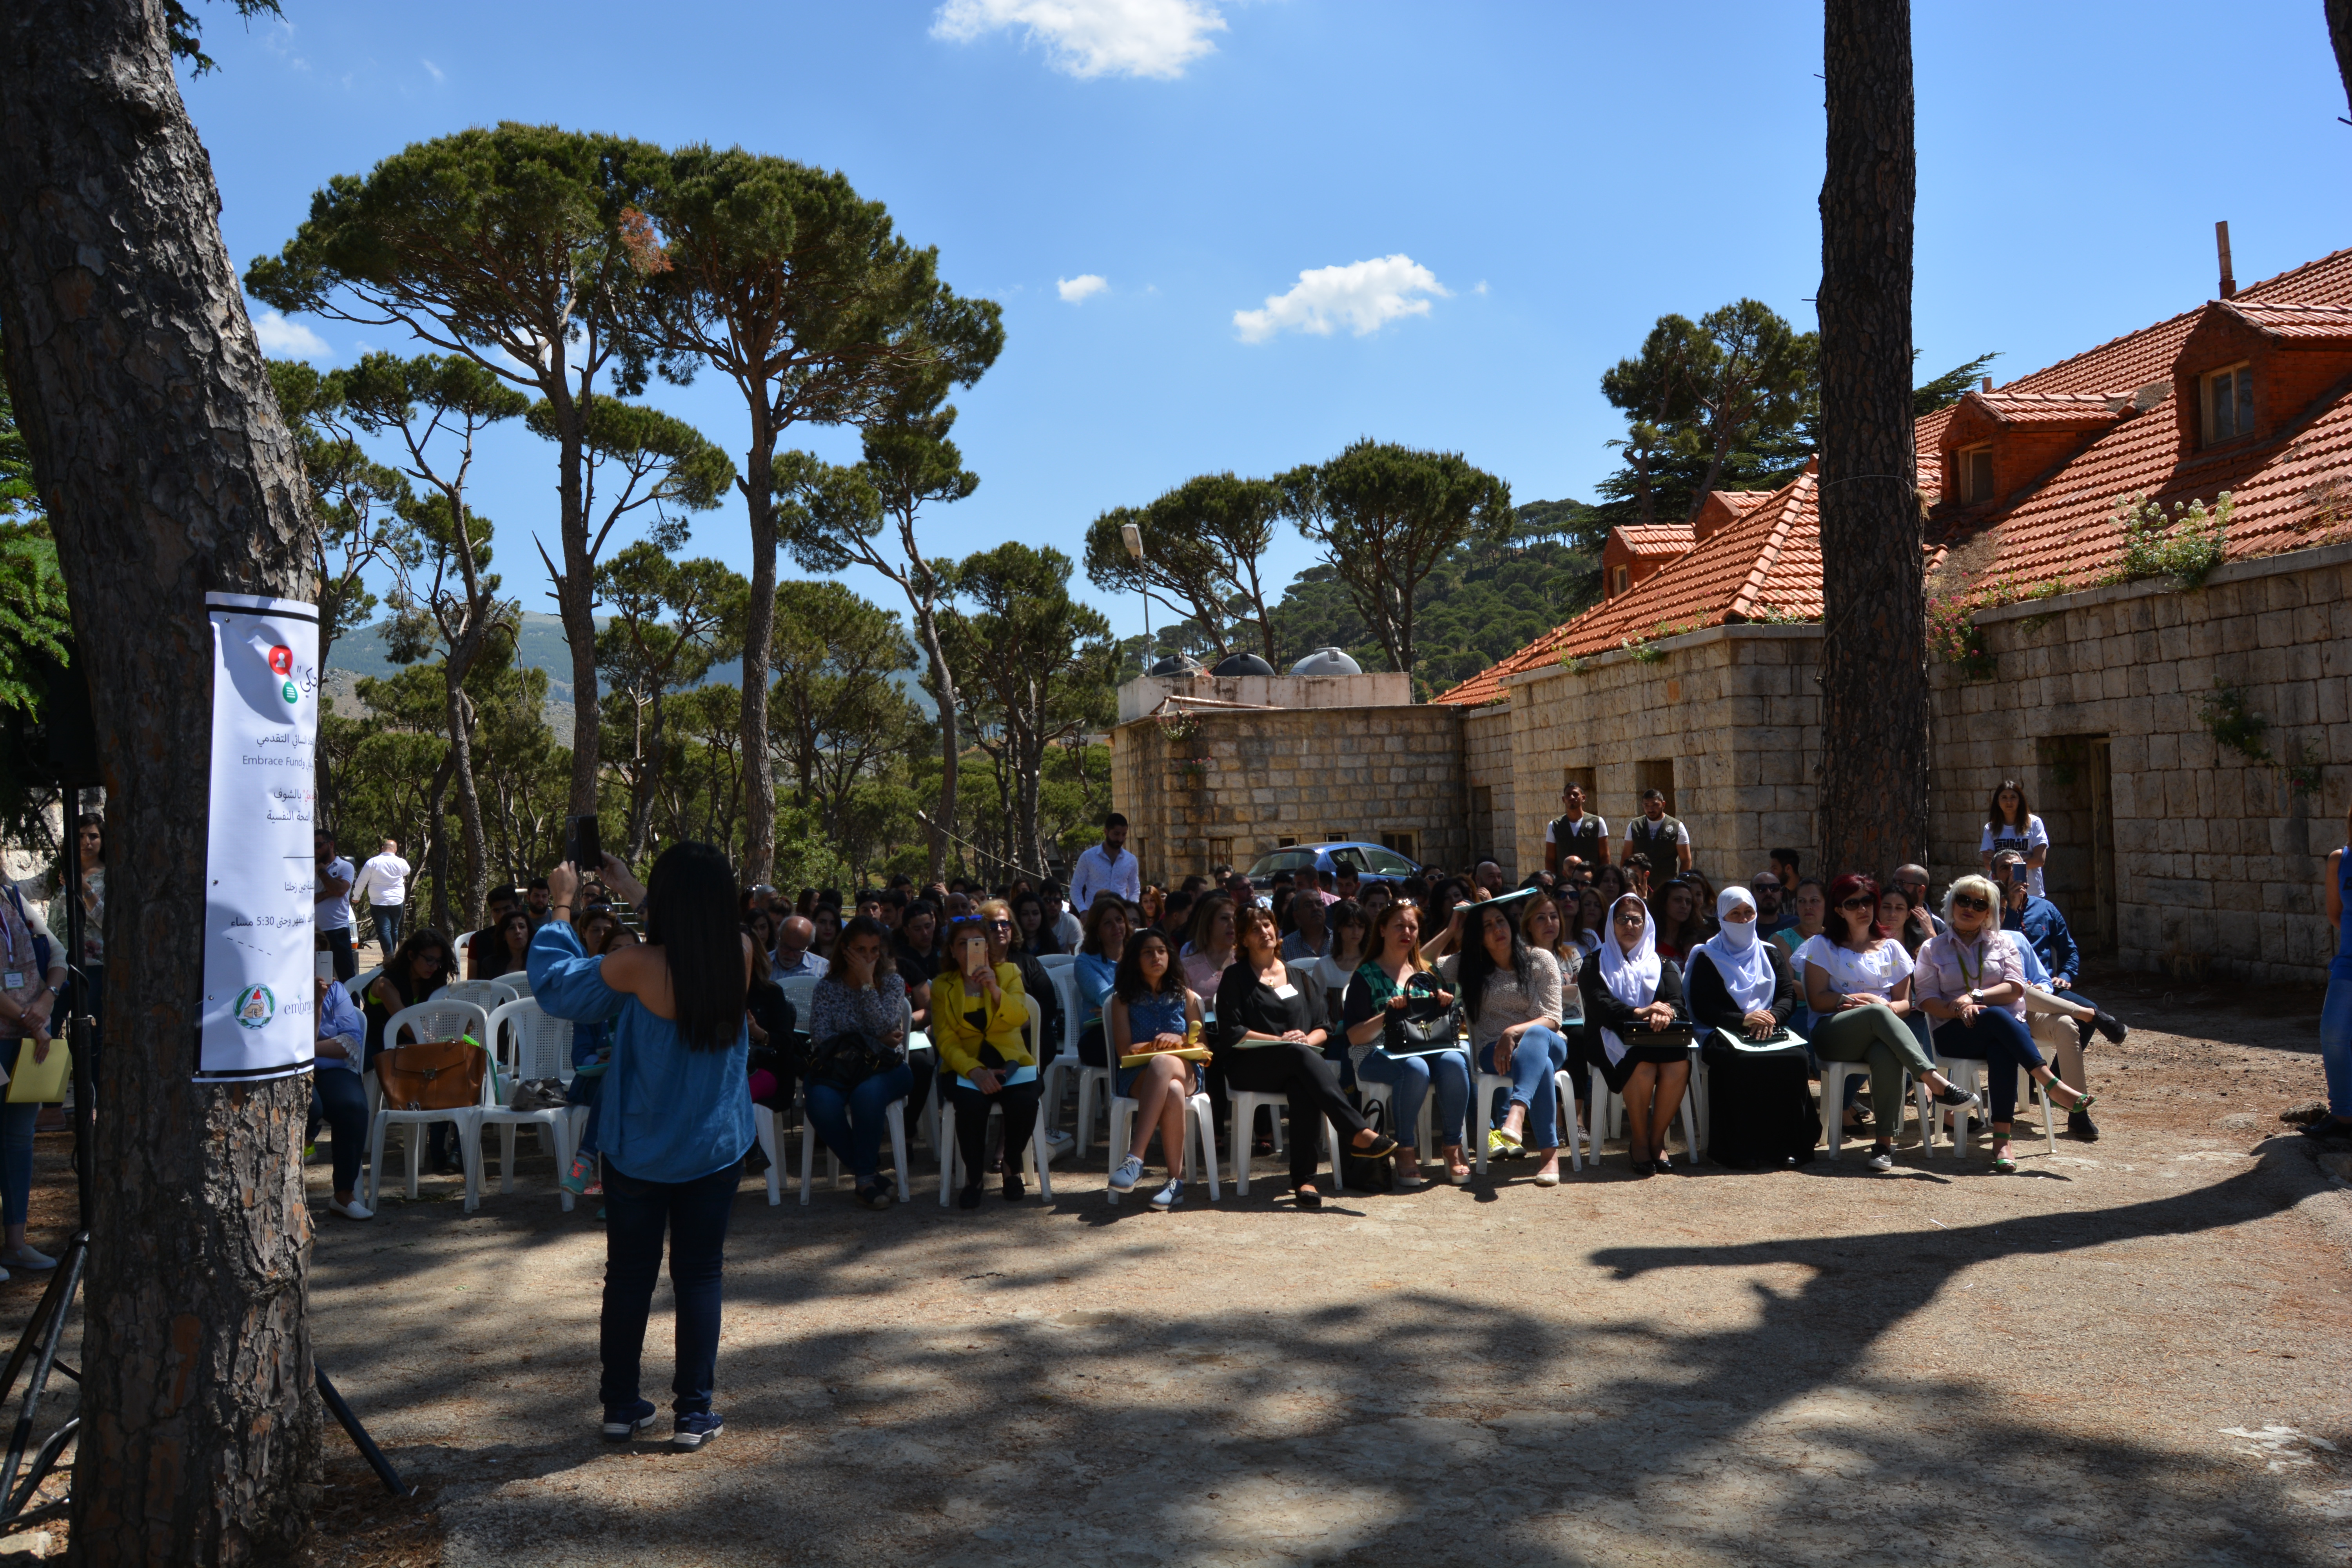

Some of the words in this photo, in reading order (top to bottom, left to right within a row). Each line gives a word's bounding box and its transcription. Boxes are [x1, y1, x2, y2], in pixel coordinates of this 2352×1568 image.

[257, 733, 289, 748] التقدمي
[242, 755, 283, 766] Embrace
[274, 788, 301, 802] بالشوف
[267, 809, 294, 824] النفسية
[230, 916, 253, 926] مساء
[257, 916, 274, 926] 5:30
[276, 917, 291, 928] وحتى
